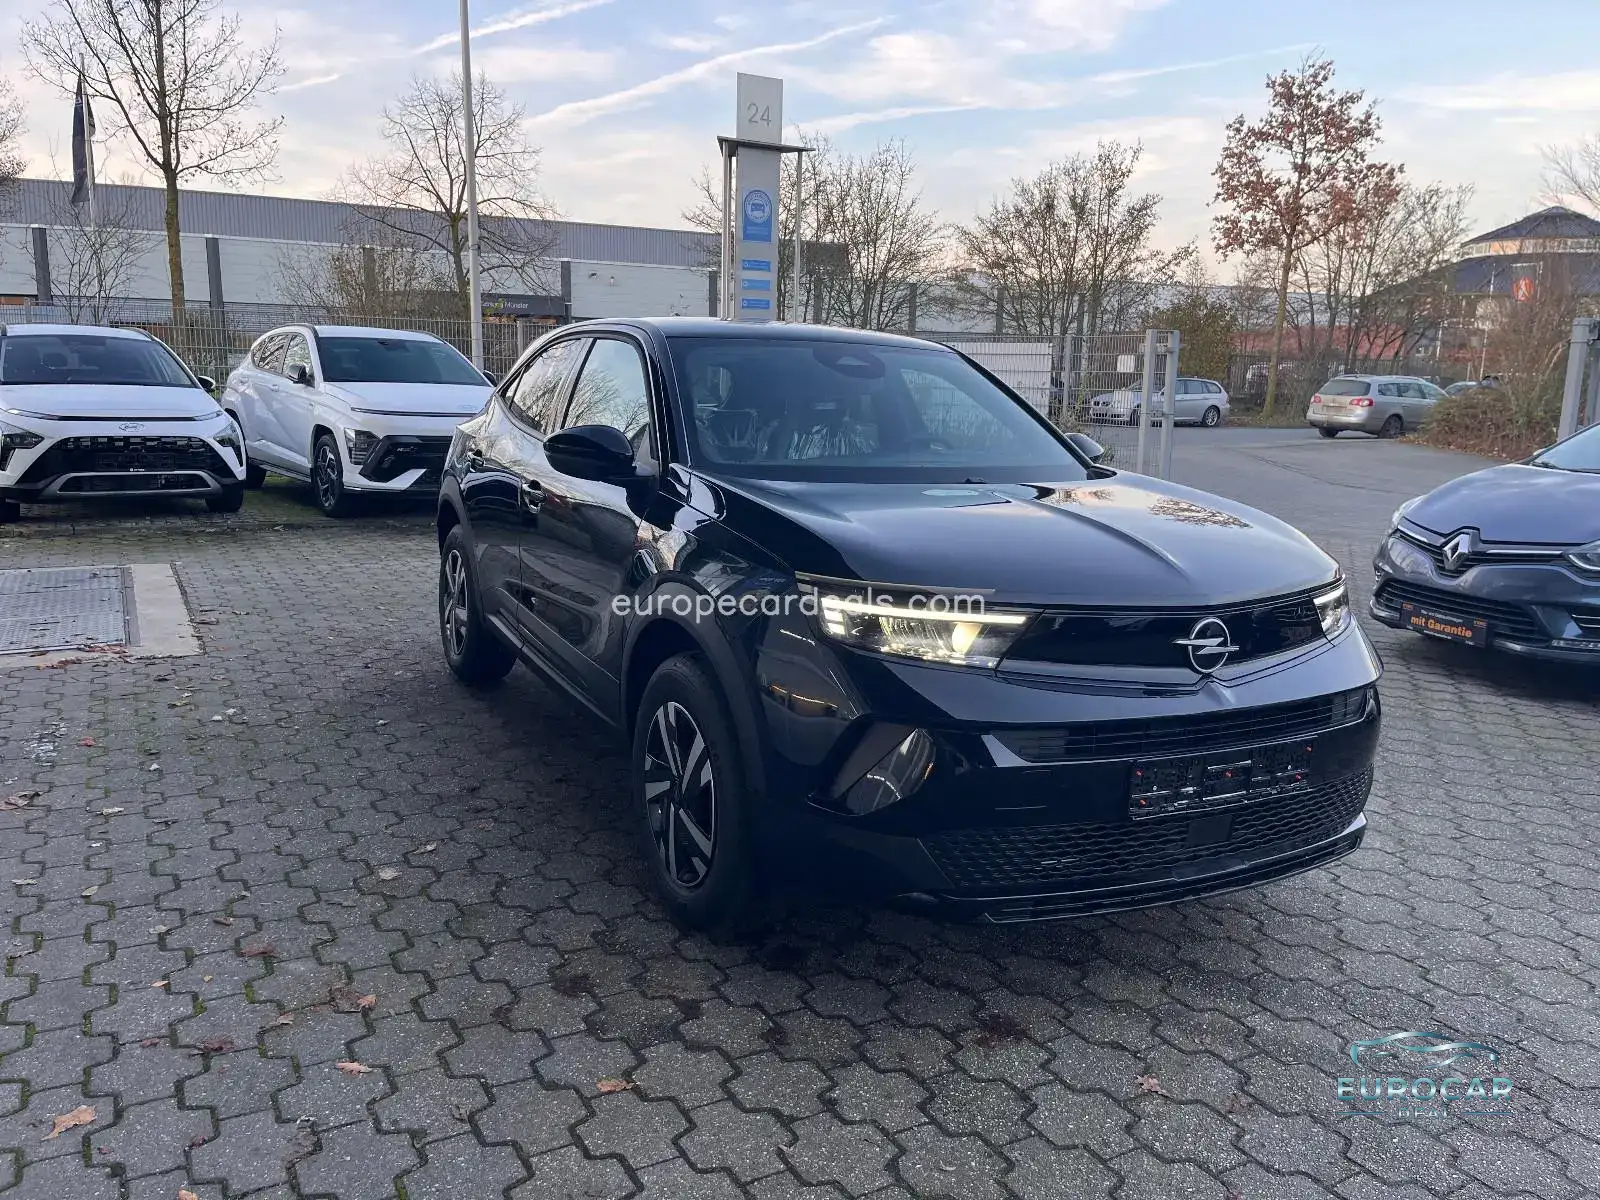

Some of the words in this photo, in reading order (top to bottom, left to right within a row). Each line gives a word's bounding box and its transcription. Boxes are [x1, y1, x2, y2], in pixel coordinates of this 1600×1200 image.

[747, 103, 772, 126] 24
[1410, 615, 1426, 627] mit
[1427, 618, 1473, 638] Garantie
